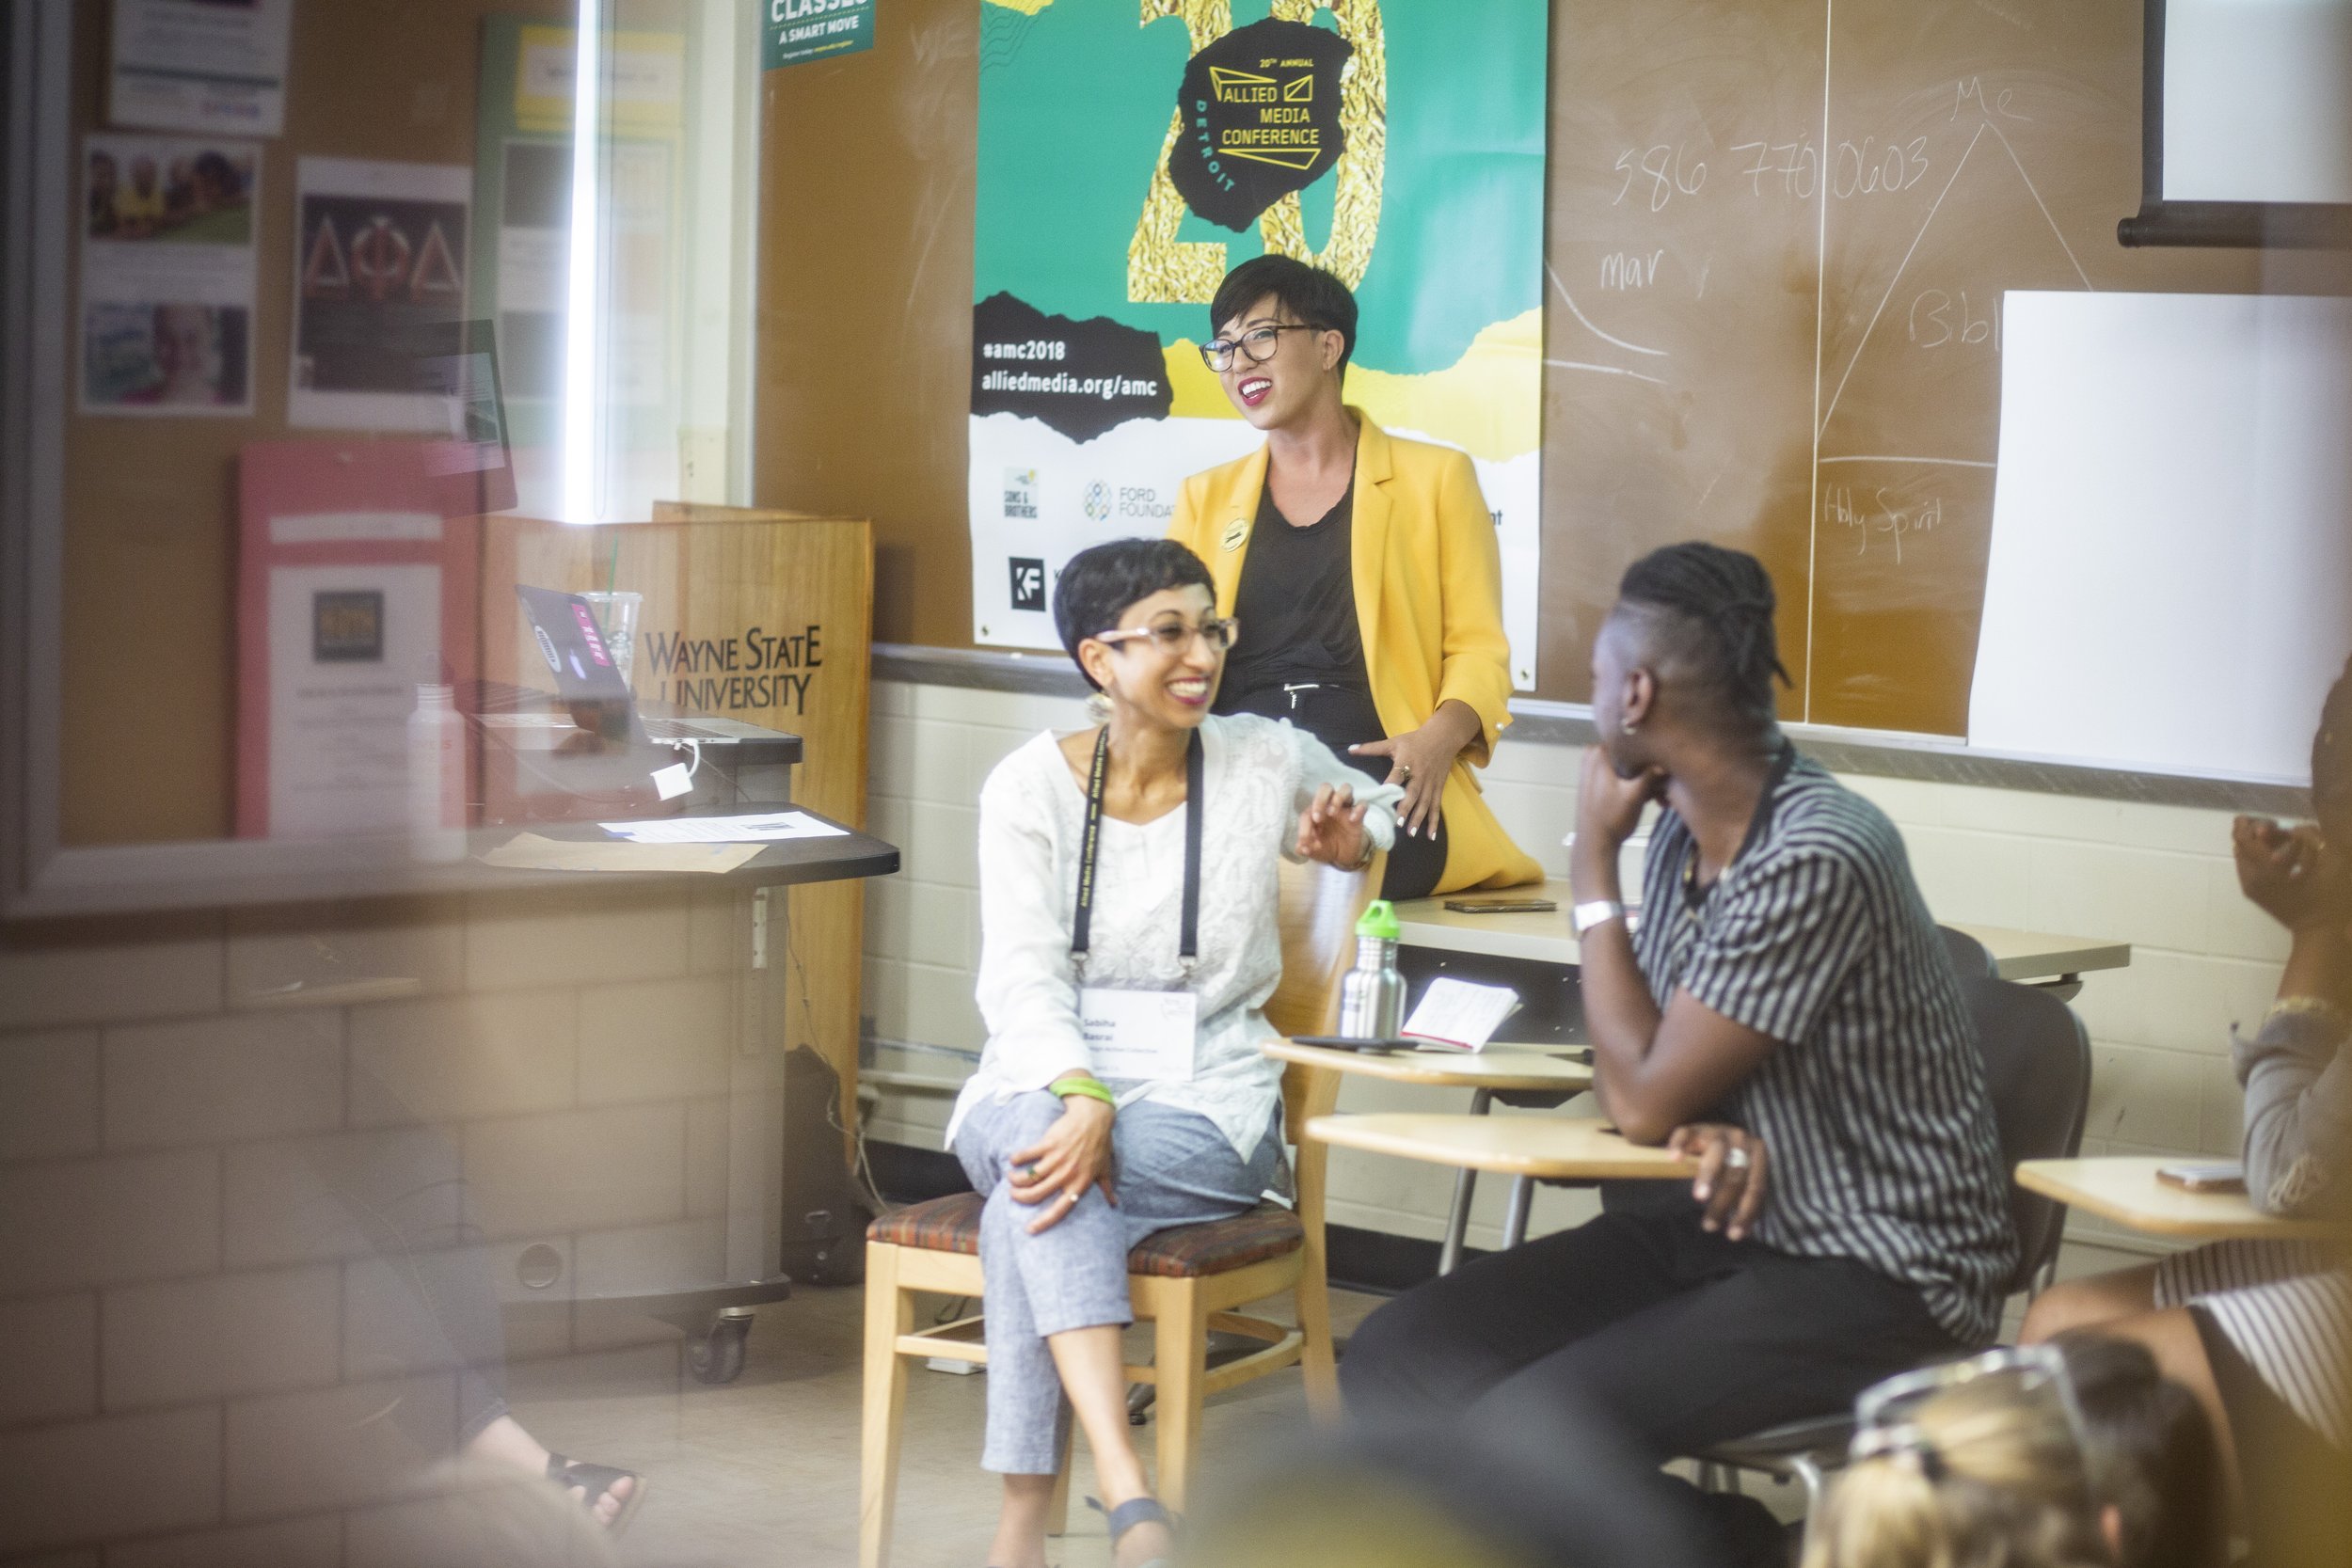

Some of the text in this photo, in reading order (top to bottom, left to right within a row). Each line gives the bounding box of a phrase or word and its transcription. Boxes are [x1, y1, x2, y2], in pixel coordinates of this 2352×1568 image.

[771, 0, 867, 23] CLAS
[778, 15, 860, 45] A SMART MOVE
[1279, 58, 1314, 68] ANNUAL
[1222, 87, 1279, 103] ALLIED
[1949, 75, 2032, 123] Me
[1260, 107, 1311, 124] MEDIA
[1196, 99, 1235, 192] DETROIT
[1221, 128, 1320, 146] CONFERENCE
[1612, 135, 1930, 213] 586 770 0603
[983, 341, 1066, 361] #amc2018
[981, 371, 1157, 401] alliedmedia.org/amc
[1004, 490, 1023, 503] SONS
[1119, 487, 1156, 503] FORD
[1004, 504, 1038, 519] BROTHERS
[1823, 483, 1867, 557] Holy
[644, 631, 739, 676] WAYNE
[744, 625, 822, 671] STATE
[659, 673, 813, 716] UNIVERSITY
[1094, 757, 1103, 778] Media
[1091, 779, 1101, 799] Allied
[1080, 825, 1096, 908] Allied Media Conference
